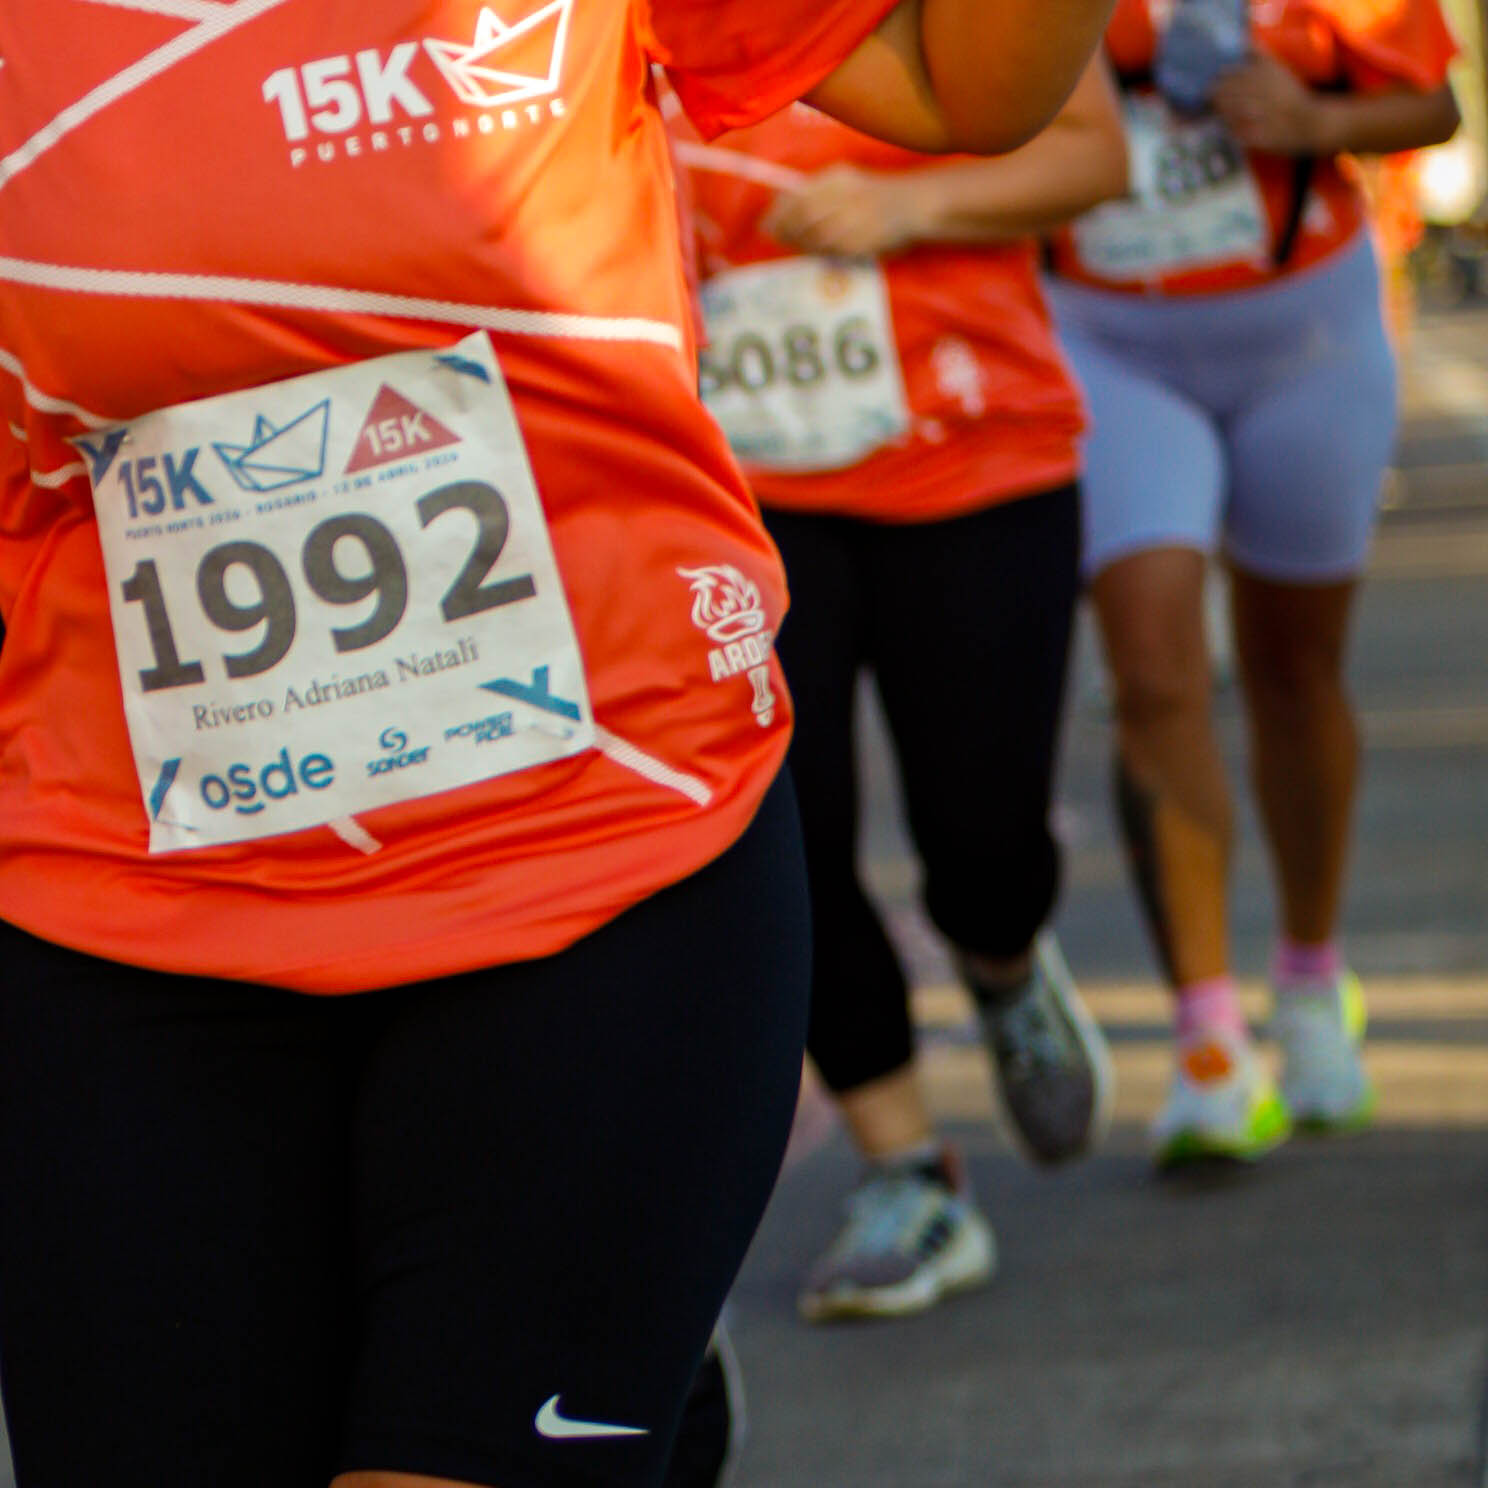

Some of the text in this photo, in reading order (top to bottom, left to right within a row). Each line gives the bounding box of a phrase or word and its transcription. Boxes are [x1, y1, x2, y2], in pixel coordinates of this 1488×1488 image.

[262, 41, 435, 142] 15K
[290, 98, 568, 168] PUERTO NORTE
[365, 412, 433, 458] 15K
[118, 447, 215, 518] 15K
[120, 479, 538, 694] 1992
[192, 701, 274, 731] Rivero
[283, 666, 391, 713] Adriana
[200, 747, 335, 814] osde
